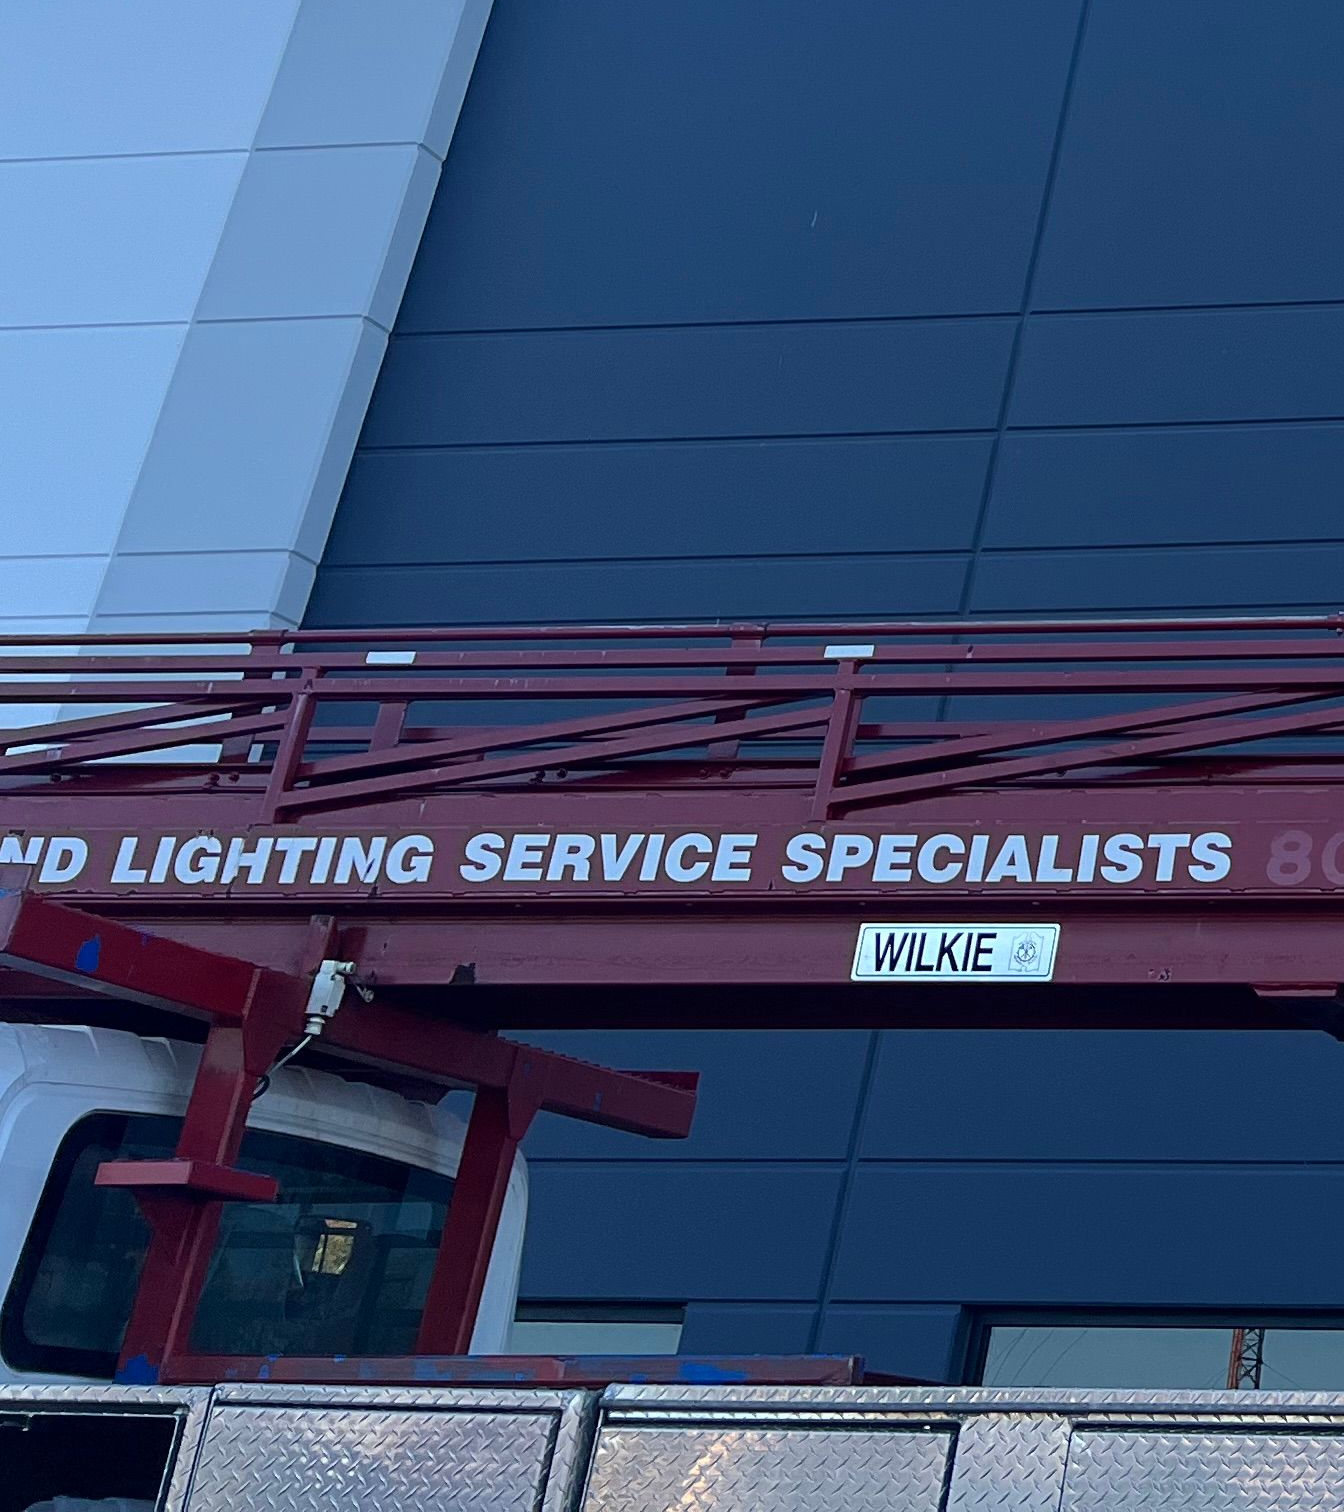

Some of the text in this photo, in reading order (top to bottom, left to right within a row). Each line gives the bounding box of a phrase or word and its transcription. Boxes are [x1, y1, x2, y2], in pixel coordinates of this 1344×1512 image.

[110, 835, 434, 884] LIGHTING
[459, 833, 758, 883] SERVICE
[781, 832, 1232, 884] SPECIALISTS
[874, 932, 998, 972] WILKIE
